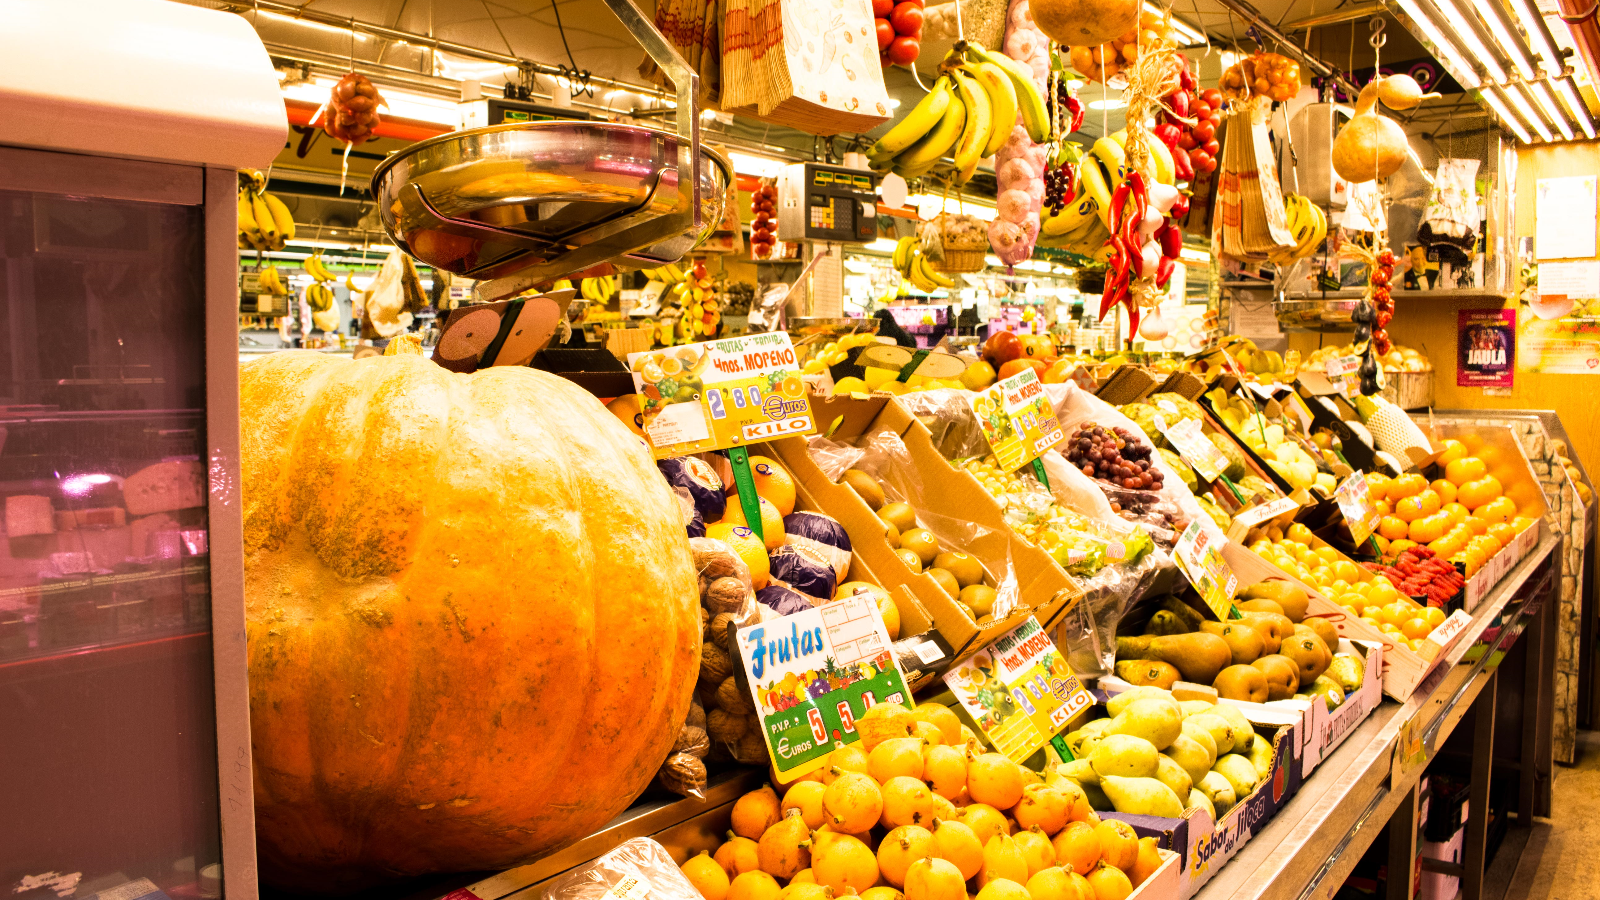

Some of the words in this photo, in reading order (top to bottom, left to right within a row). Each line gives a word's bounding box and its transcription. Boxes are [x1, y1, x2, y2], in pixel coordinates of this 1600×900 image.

[1467, 349, 1506, 364] JAULA
[1019, 380, 1042, 400] MORENO
[747, 419, 807, 437] KILO
[1037, 432, 1061, 450] KILO
[994, 635, 1015, 655] FRUTAS
[1014, 618, 1040, 642] VERDURAS
[748, 621, 824, 680] Frutas
[1001, 653, 1025, 673] Hnos.
[1017, 631, 1051, 662] MORENO
[1053, 694, 1086, 723] KILO
[771, 719, 792, 734] P.V.P.
[1195, 826, 1229, 870] Sabor
[1224, 834, 1235, 855] del
[1235, 795, 1265, 842] Jiloca
